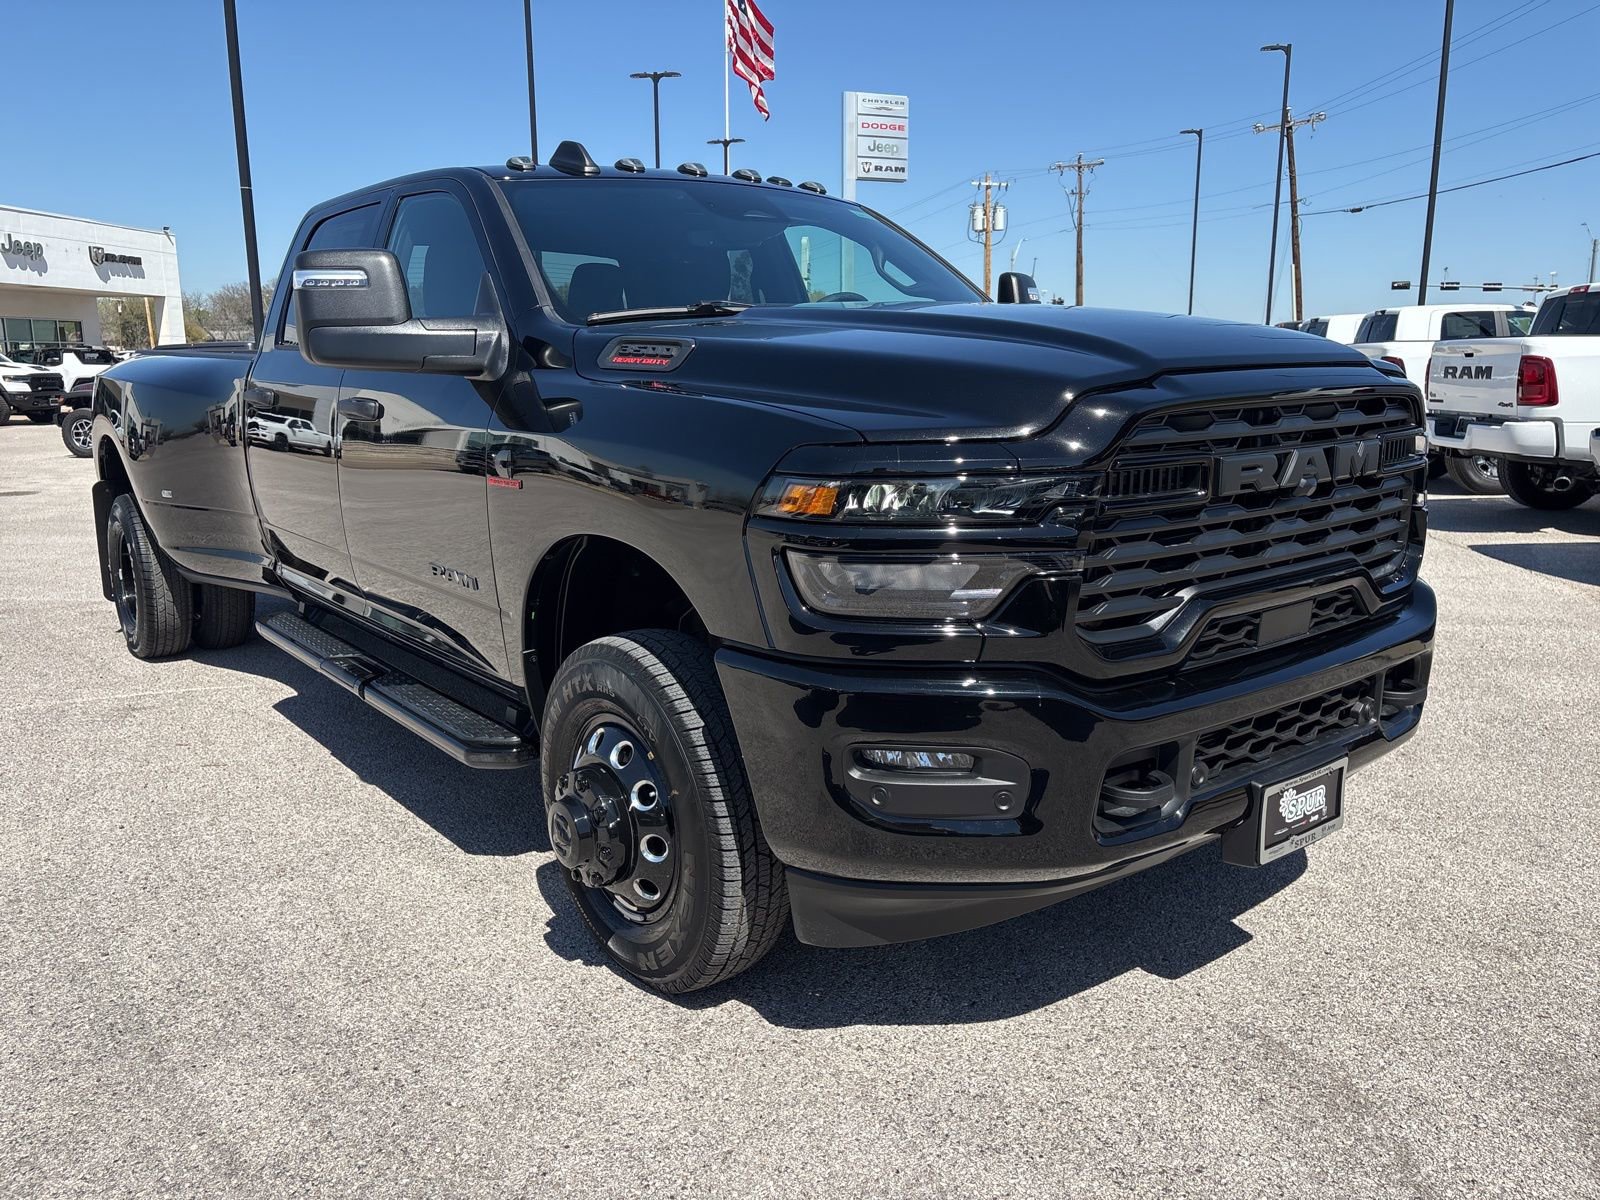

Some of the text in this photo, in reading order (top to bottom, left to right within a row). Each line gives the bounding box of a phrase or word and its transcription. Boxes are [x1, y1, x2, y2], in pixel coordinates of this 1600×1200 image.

[862, 122, 905, 131] DODGE
[868, 140, 899, 155] Jeep
[874, 165, 906, 173] RAM
[1, 233, 43, 260] Jeep
[612, 356, 670, 366] HEAVY DUTY
[1443, 366, 1493, 379] RAM
[1219, 440, 1380, 497] RAM
[430, 561, 480, 591] RAM
[562, 672, 594, 704] HTX
[1286, 786, 1325, 822] SPUR
[1294, 833, 1316, 849] SPUR
